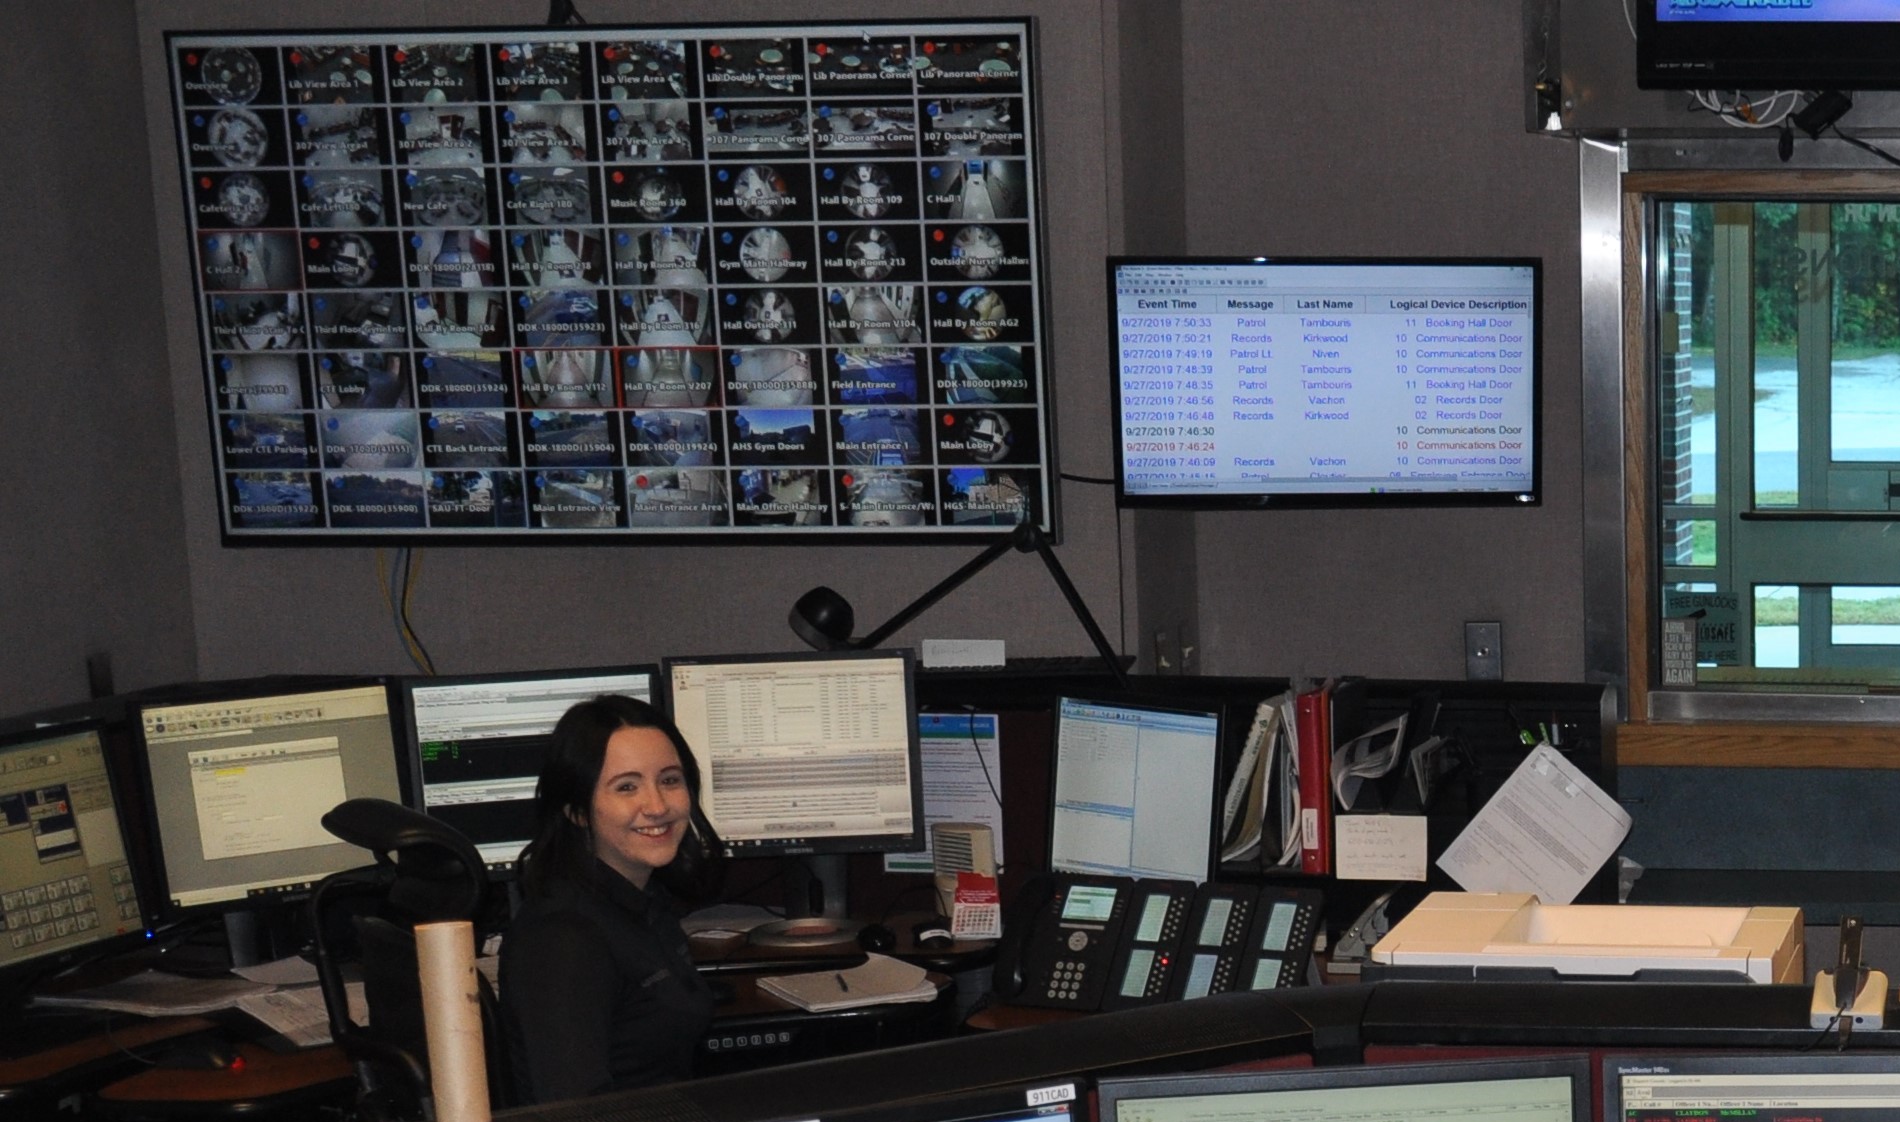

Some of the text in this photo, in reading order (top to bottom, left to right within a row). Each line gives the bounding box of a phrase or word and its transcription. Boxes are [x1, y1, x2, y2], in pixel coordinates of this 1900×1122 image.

[1138, 299, 1526, 310] Event Time Message Last Name Logical Device Description
[1670, 596, 1690, 610] FREE
[1665, 668, 1693, 682] AGAIN
[1032, 1088, 1069, 1102] 911CAD
